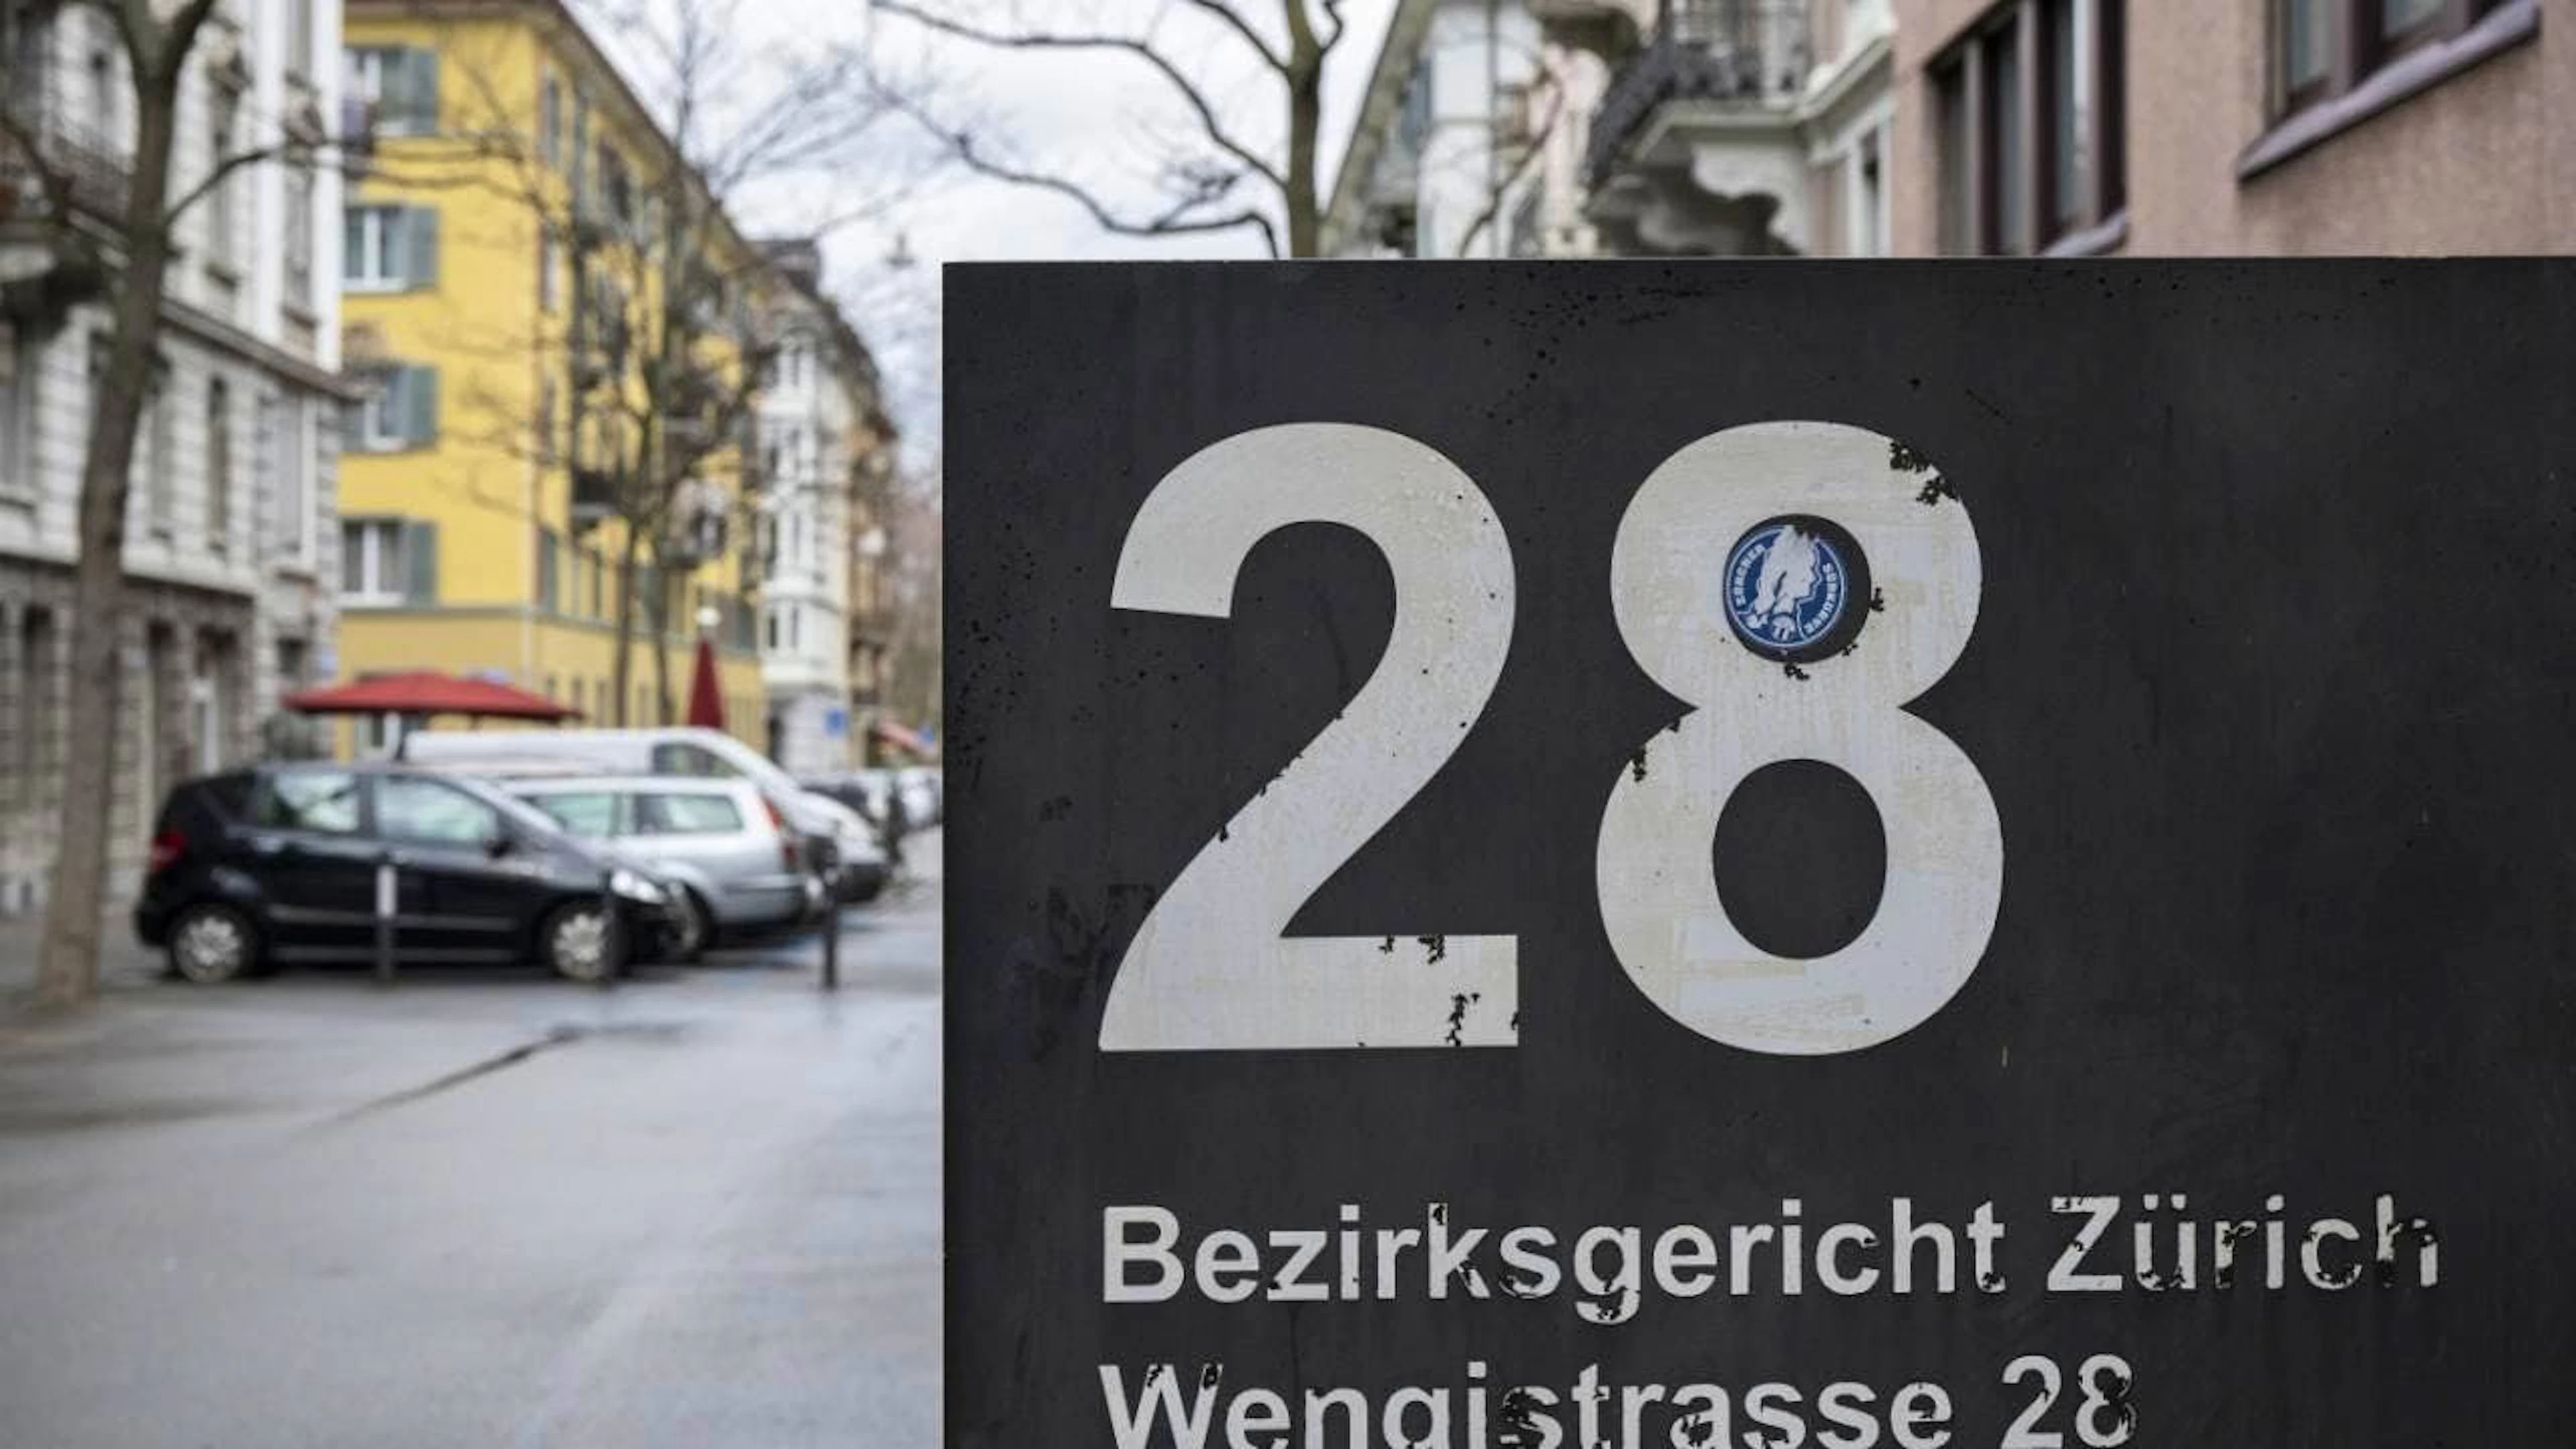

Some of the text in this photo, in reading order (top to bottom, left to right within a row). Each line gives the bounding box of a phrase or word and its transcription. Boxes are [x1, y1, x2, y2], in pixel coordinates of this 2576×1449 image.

[1099, 421, 2004, 1055] 28
[1103, 1194, 2438, 1325] Bezirksgericht Zürich
[1098, 1354, 2136, 1449] Wengistrasse 28
